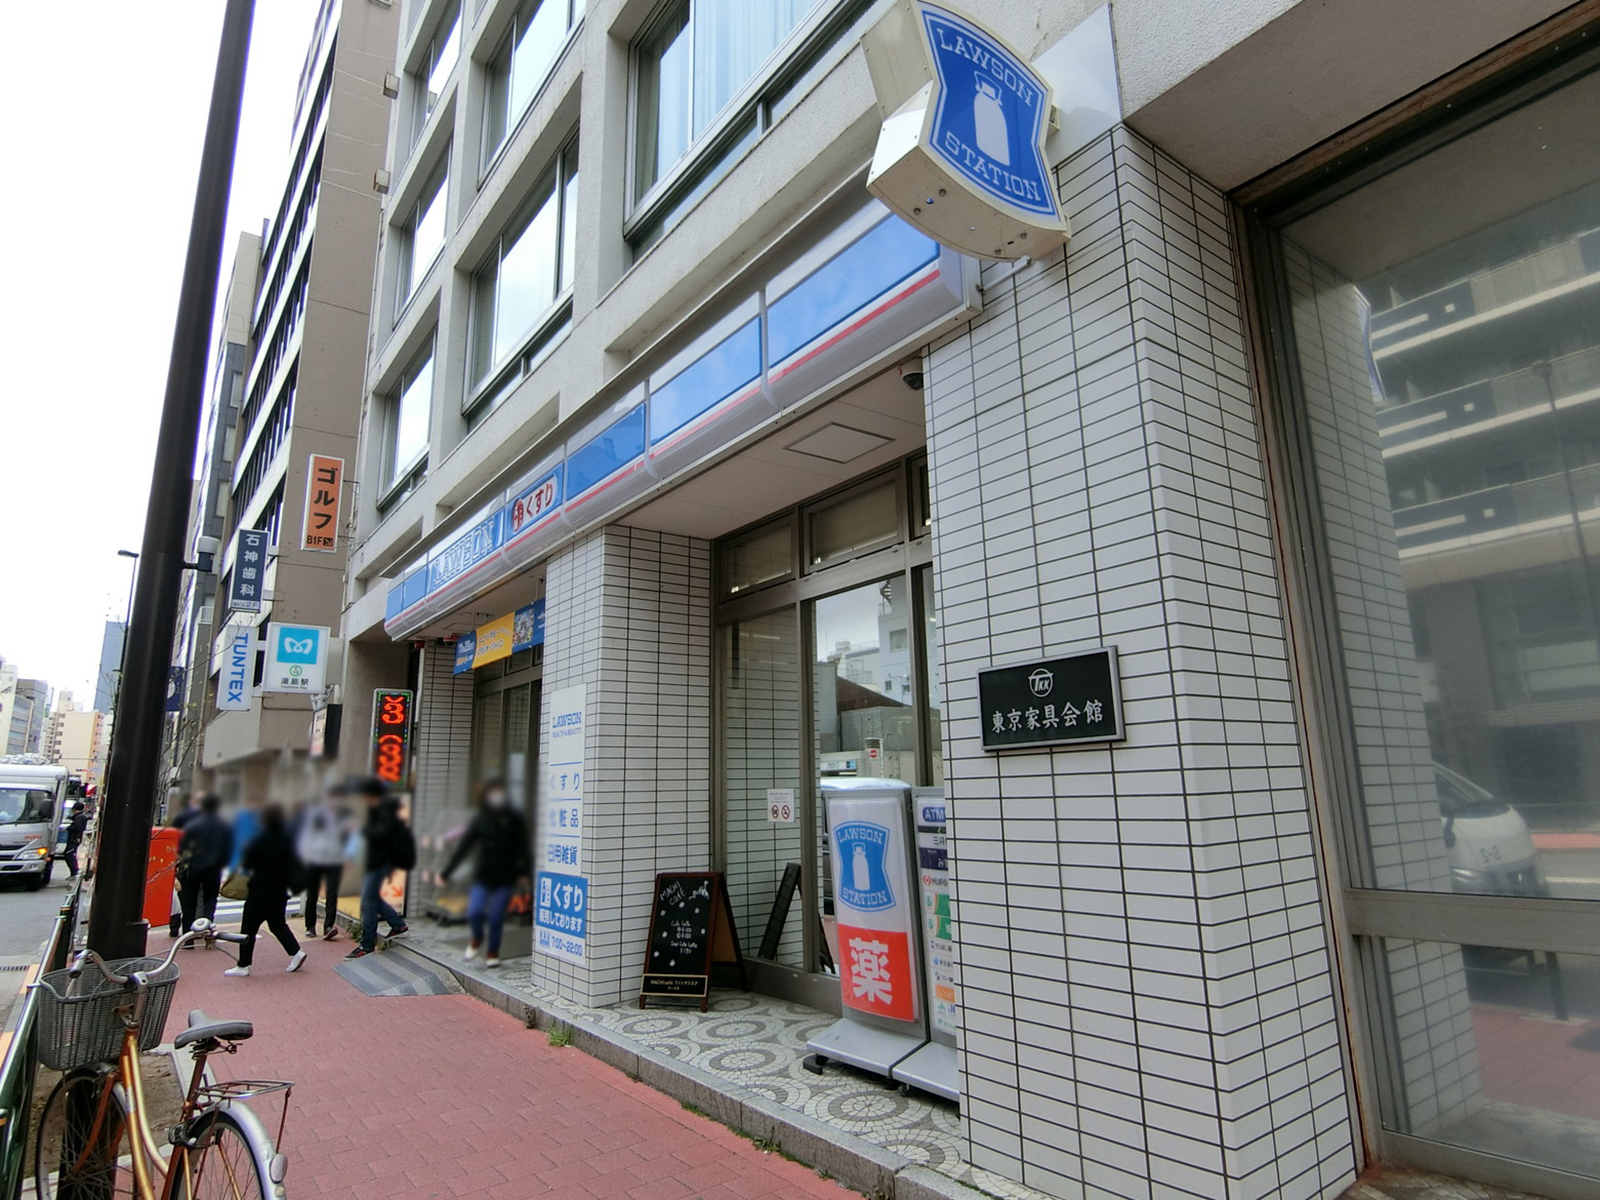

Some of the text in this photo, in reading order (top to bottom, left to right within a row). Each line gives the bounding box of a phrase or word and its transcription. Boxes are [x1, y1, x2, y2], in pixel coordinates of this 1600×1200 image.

[937, 28, 1033, 107] LAWSON
[945, 131, 1041, 201] STATION
[313, 467, 338, 530] ゴルフ
[526, 483, 553, 518] くすり
[307, 535, 323, 545] B1F
[240, 533, 261, 597] 石神歯科
[227, 633, 249, 703] TUNTEX
[552, 711, 582, 728] LAWSON
[991, 699, 1103, 734] 東京家具会館
[924, 808, 945, 820] ATM
[837, 827, 883, 845] LAWSON
[553, 882, 583, 912] くすり
[842, 890, 887, 906] STATION
[931, 877, 948, 887] MUFG
[539, 908, 582, 932] 販売しております
[849, 937, 893, 1005] 薬
